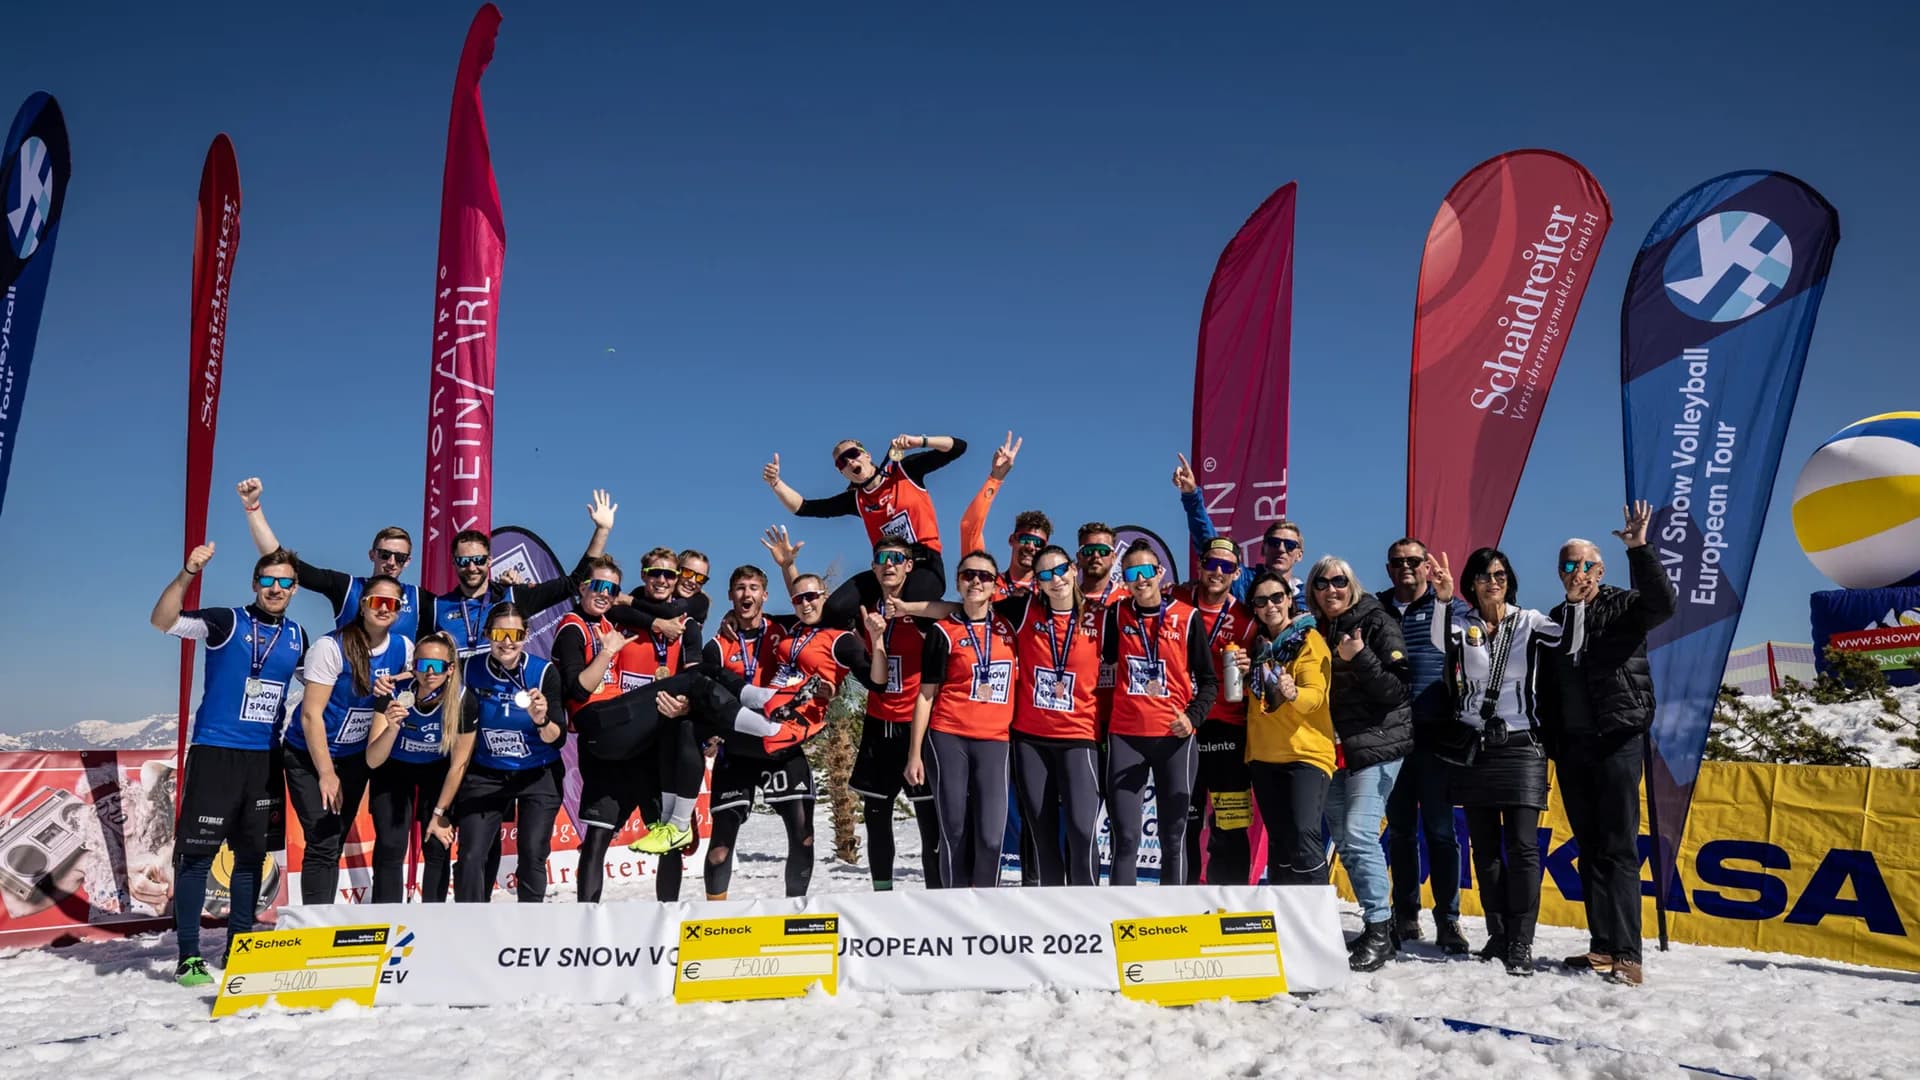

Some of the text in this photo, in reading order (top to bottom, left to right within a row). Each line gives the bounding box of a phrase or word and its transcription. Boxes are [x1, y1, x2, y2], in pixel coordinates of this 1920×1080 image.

[1471, 205, 1577, 415] Schaidreiter
[1510, 211, 1599, 421] Versicherungsmakler GmbH
[1671, 347, 1710, 469] Volleyball
[1662, 474, 1692, 544] Snow
[1690, 421, 1737, 605] European Tour
[886, 522, 907, 535] NOW
[1084, 612, 1096, 627] 2
[1170, 614, 1179, 628] 1
[1221, 614, 1235, 629] 2
[995, 622, 1008, 634] 3
[1080, 627, 1098, 637] TUR
[1163, 630, 1180, 640] TUR
[1216, 630, 1235, 640] AUT
[988, 671, 1007, 679] OW
[991, 683, 1005, 691] ACE
[256, 691, 279, 700] NOW
[1039, 690, 1068, 700] SPAE
[501, 703, 509, 717] 1
[420, 722, 440, 732] CZE
[423, 733, 436, 743] 3
[761, 770, 789, 793] 20
[703, 926, 752, 936] Scheck
[1138, 924, 1188, 936] Scheck
[254, 937, 302, 950] Scheck
[498, 946, 552, 968] CEV
[557, 946, 643, 968] SNOW
[837, 935, 954, 958] UROPEAN
[961, 935, 1033, 957] TOUR
[1042, 933, 1103, 955] 2022
[1173, 958, 1224, 980] 450,00
[379, 970, 409, 984] EV
